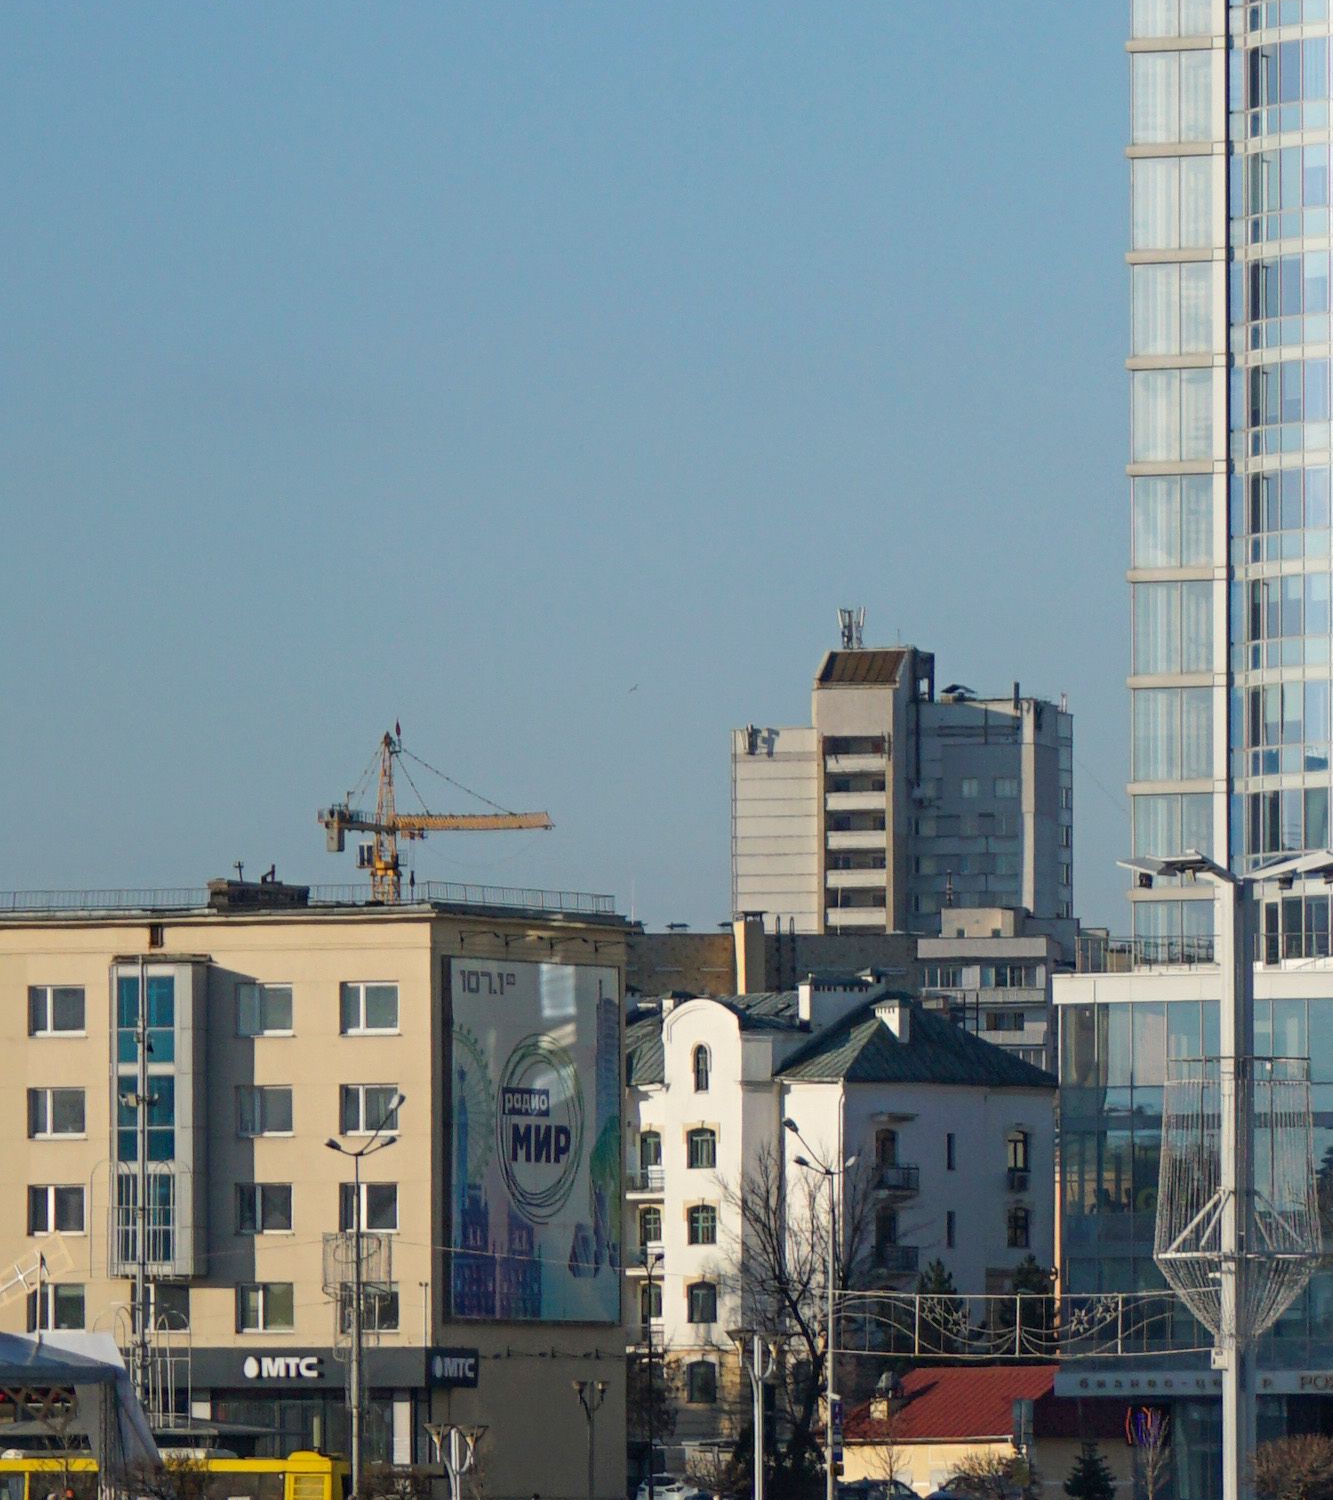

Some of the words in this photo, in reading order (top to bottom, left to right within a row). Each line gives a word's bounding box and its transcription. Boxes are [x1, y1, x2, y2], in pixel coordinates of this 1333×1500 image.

[460, 970, 504, 995] 107.1
[504, 1092, 549, 1115] радио
[512, 1123, 571, 1163] МИР
[261, 1356, 319, 1378] МТС
[444, 1357, 476, 1378] МТС
